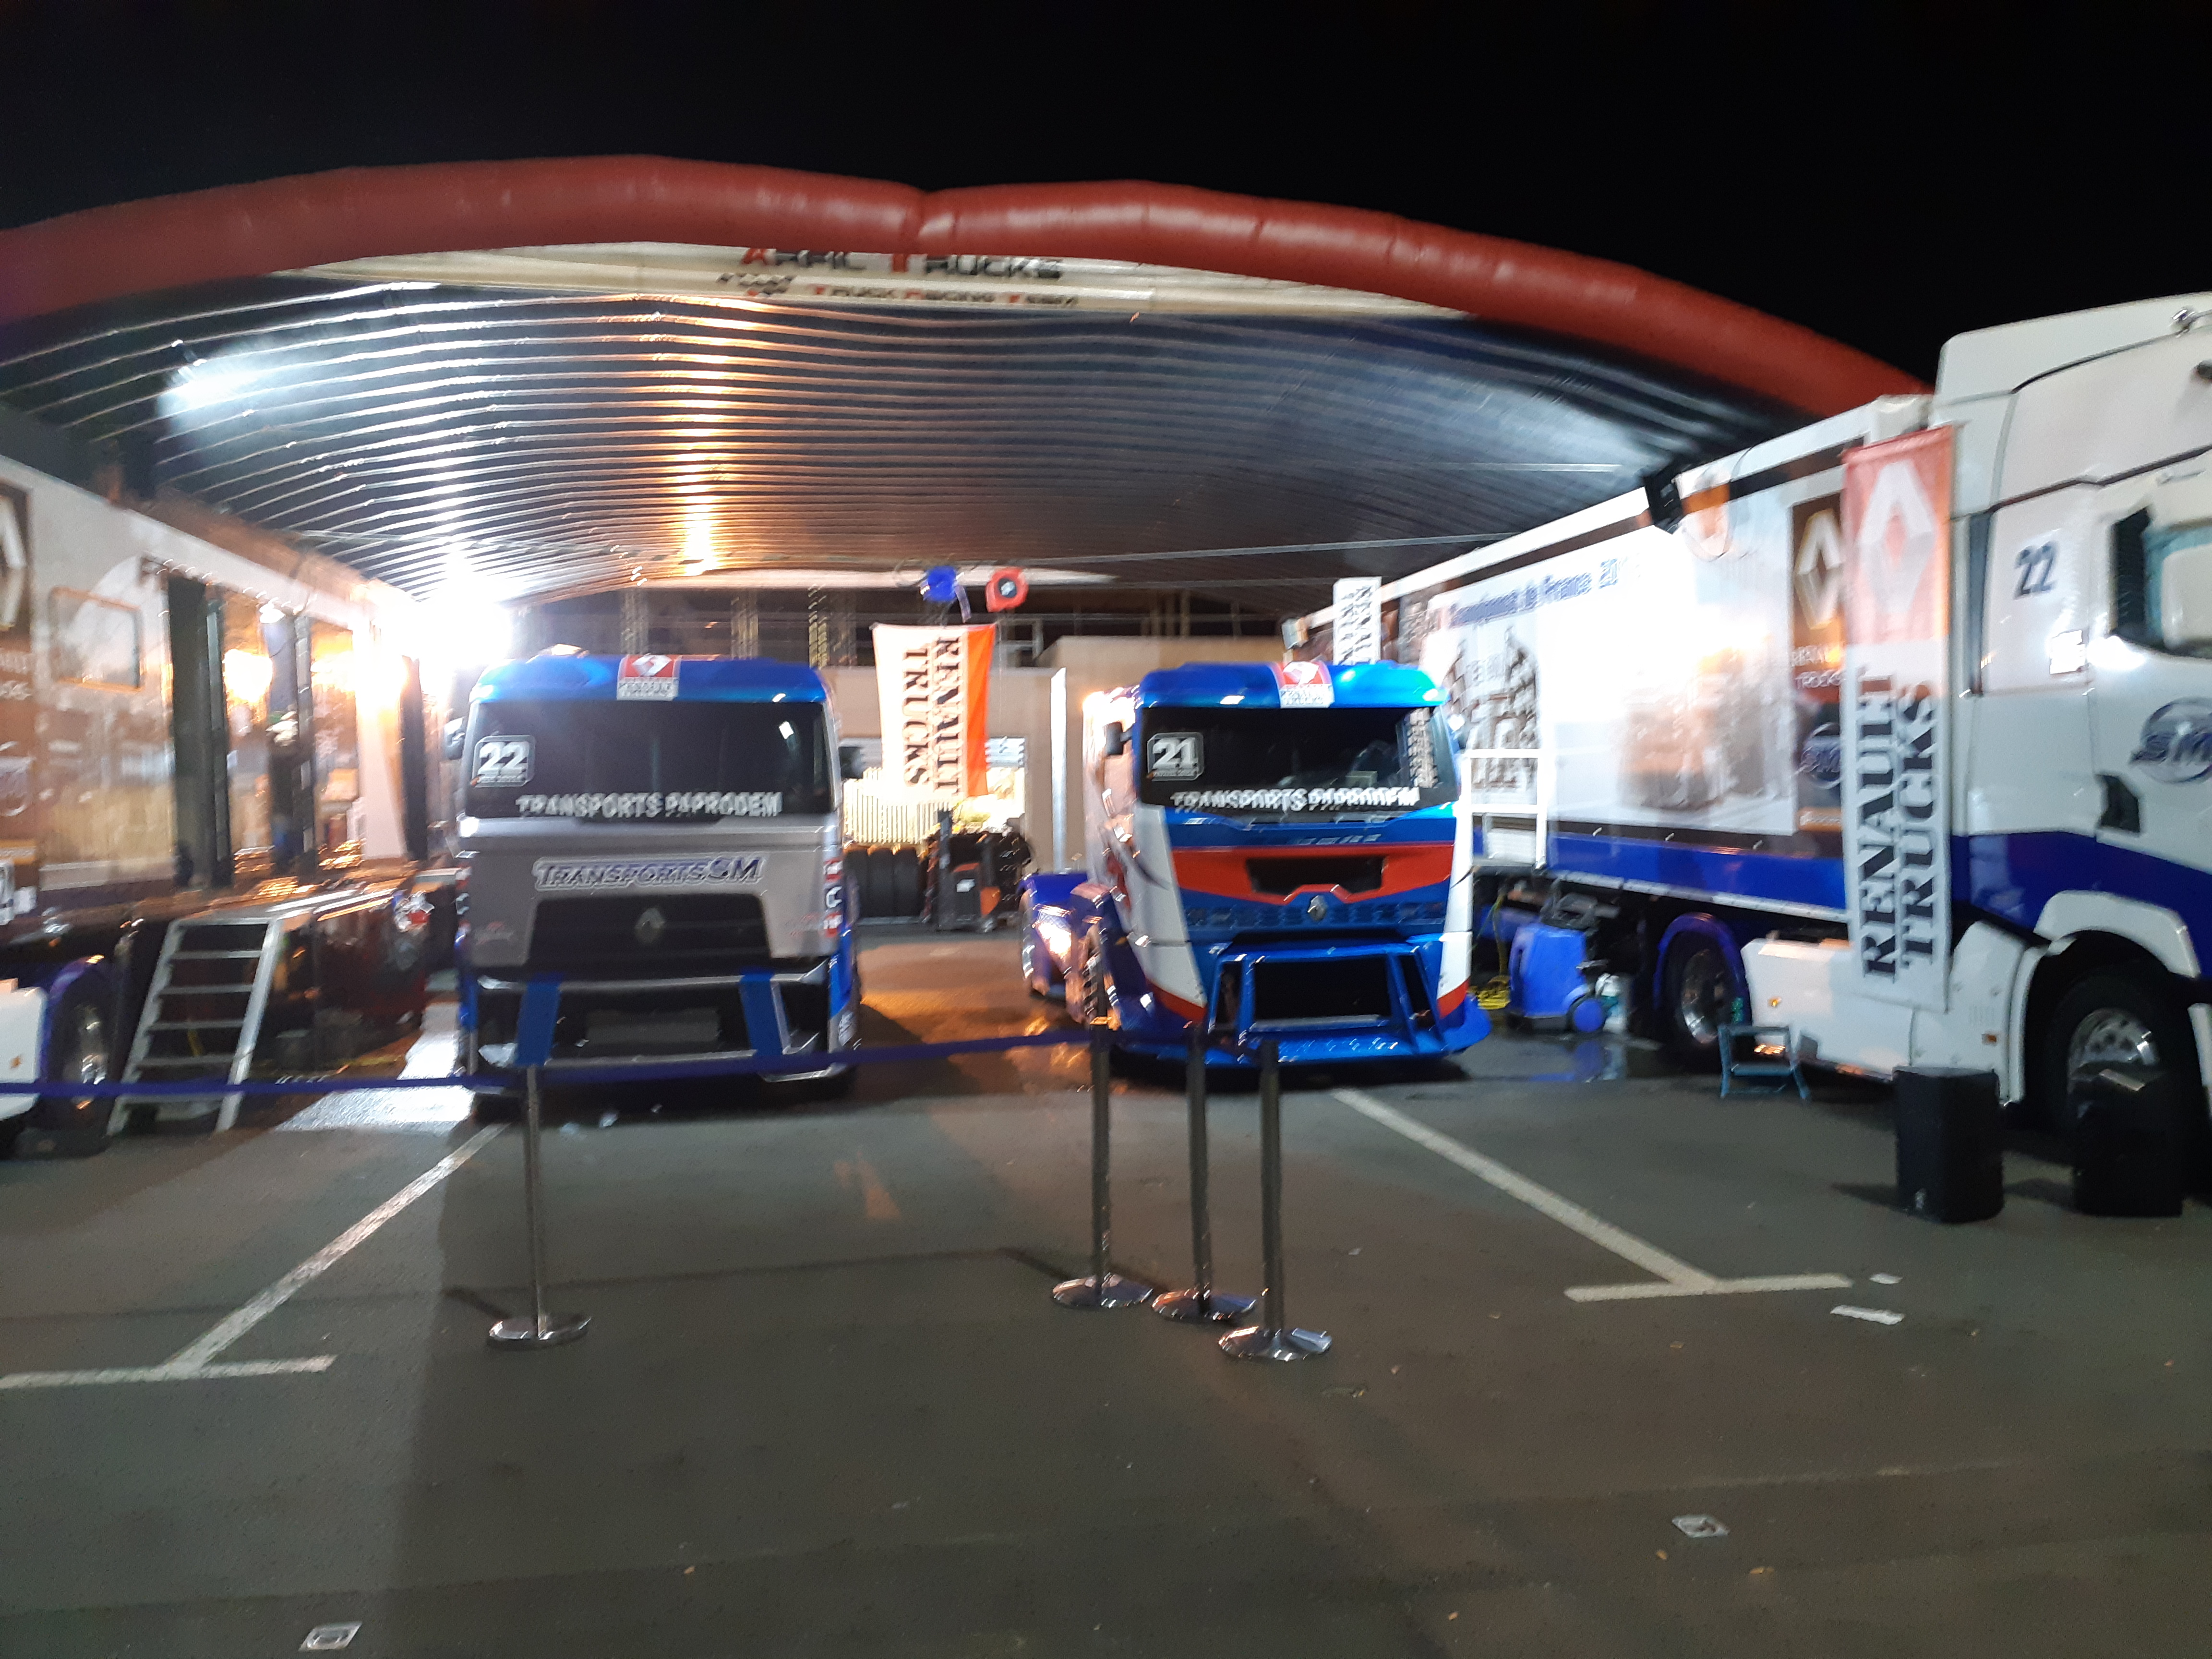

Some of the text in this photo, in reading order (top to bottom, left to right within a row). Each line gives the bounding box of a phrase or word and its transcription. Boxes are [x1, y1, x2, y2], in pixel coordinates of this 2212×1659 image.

[2014, 541, 2058, 599] 22
[902, 646, 930, 787] TRUCKS
[935, 636, 962, 797] RENAULT
[477, 741, 529, 776] 22
[1152, 737, 1199, 769] 21
[515, 792, 664, 818] TRANSPORTS
[1170, 788, 1308, 812] TRANSPORTS
[1856, 672, 1898, 983] RENAULT
[1898, 682, 1937, 971] TRUCKS
